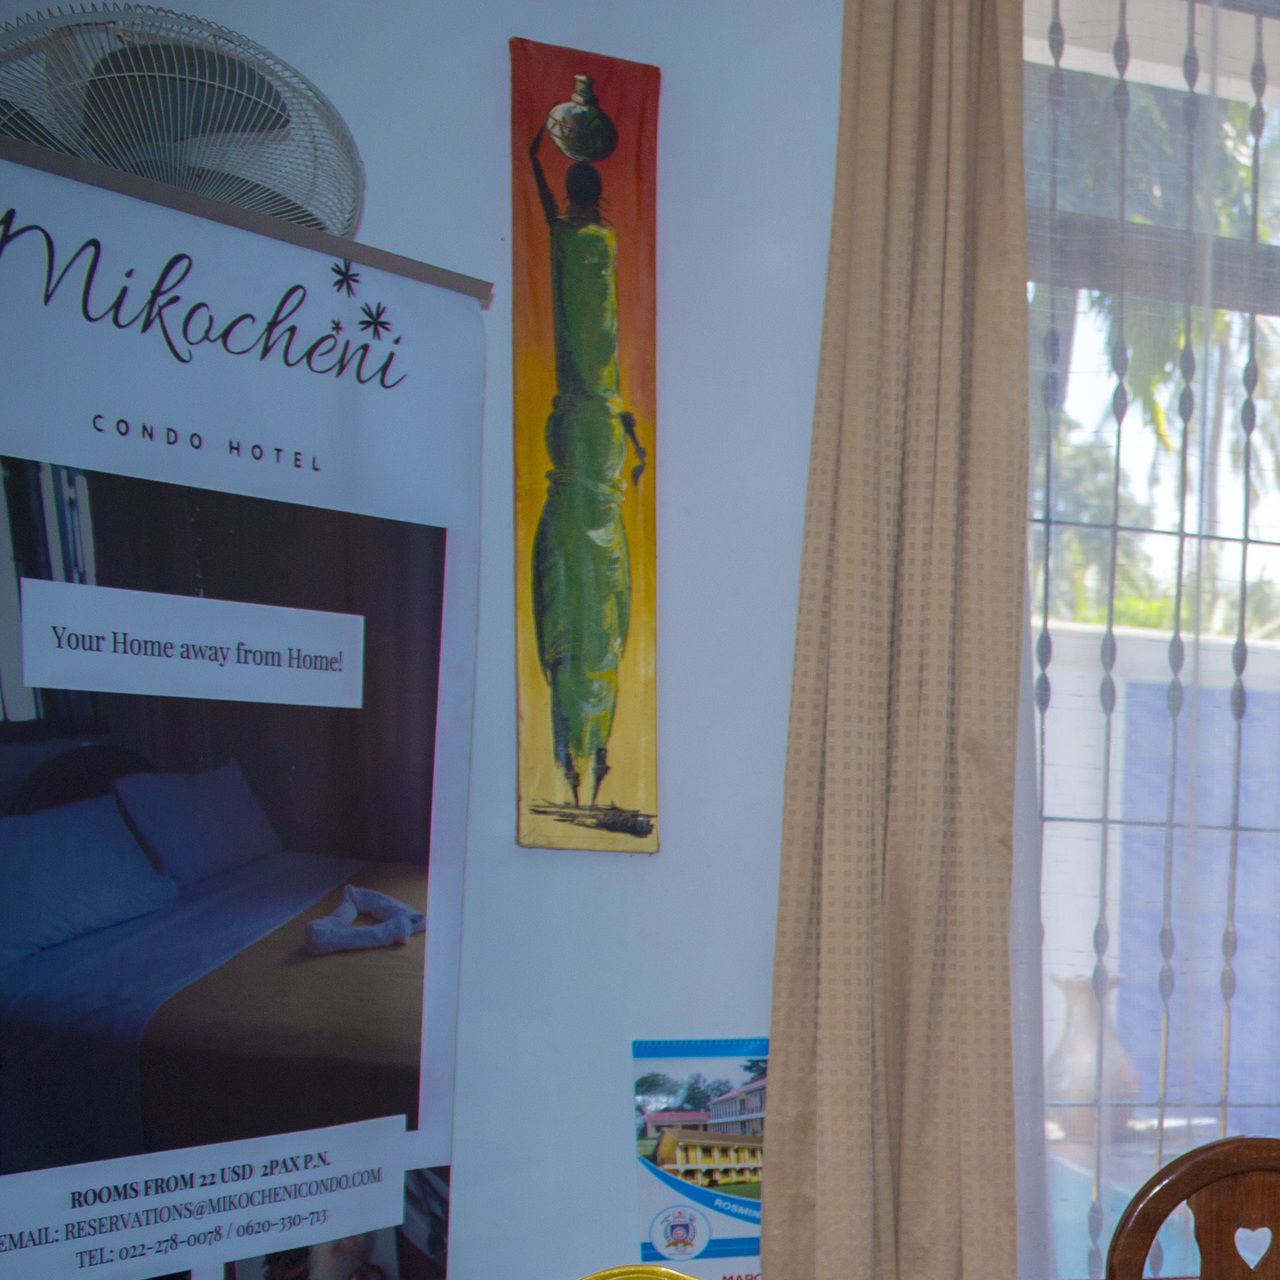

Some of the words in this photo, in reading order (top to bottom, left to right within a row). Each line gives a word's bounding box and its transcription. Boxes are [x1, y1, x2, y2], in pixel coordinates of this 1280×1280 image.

[0, 208, 408, 390] Mikocheni
[92, 413, 203, 451] CONDO
[228, 439, 322, 473] HOTEL
[51, 625, 105, 652] Your
[111, 631, 174, 658] Home
[180, 642, 231, 667] away
[235, 641, 282, 667] from
[287, 647, 344, 672] Home!
[70, 1181, 139, 1209] ROOMS
[143, 1173, 195, 1198] FROM
[199, 1172, 216, 1188] 22
[221, 1163, 253, 1184] USD
[262, 1156, 301, 1177] 2PAX
[304, 1151, 331, 1170] P.N.
[0, 1229, 60, 1253] EMAIL:
[64, 1167, 383, 1241] RESERVATIONS@MIKOCHENICONDO.COM
[76, 1248, 114, 1269] TEL:
[119, 1225, 223, 1262] 022-278-0078
